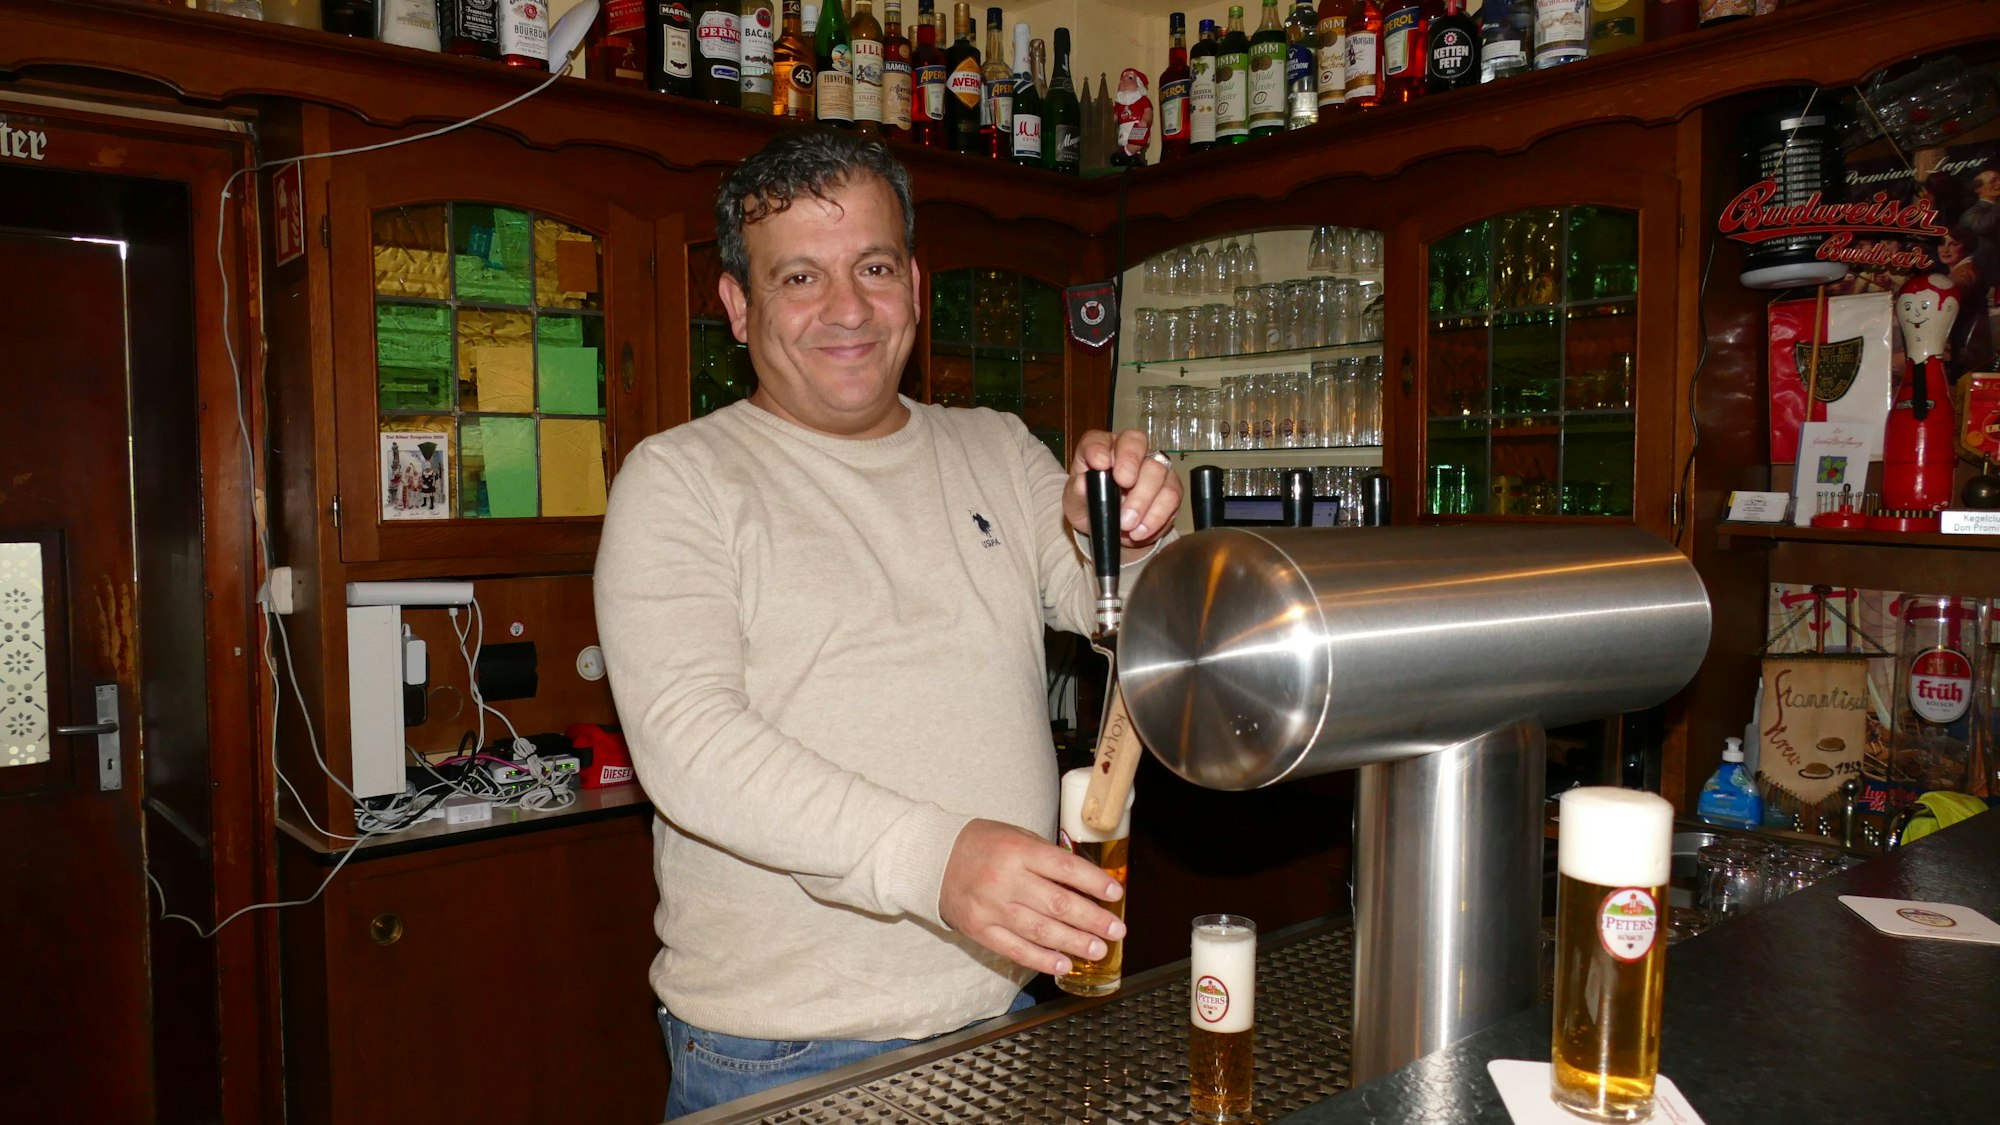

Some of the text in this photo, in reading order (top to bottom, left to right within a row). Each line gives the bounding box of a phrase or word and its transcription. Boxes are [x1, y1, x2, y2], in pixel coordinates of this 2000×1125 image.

[662, 6, 692, 19] MARTINI
[1384, 14, 1414, 34] PEROL
[514, 25, 547, 40] BOURBON
[745, 28, 774, 42] BACAR
[1352, 36, 1375, 46] Morgan
[1433, 45, 1469, 61] KETTEN
[1439, 57, 1462, 70] FETT
[796, 68, 812, 84] 43
[0, 121, 48, 161] ter
[1844, 156, 1987, 186] Premium Lager
[1718, 178, 1949, 236] Budweiser
[1814, 231, 1935, 269] Budvar
[1954, 523, 1971, 532] Don
[981, 538, 1001, 548] USPA
[1917, 680, 1963, 704] Früh
[1102, 712, 1127, 760] KÖLN
[603, 768, 631, 780] DIESEL
[1606, 916, 1654, 931] PETERS
[1198, 992, 1225, 1005] PETERS
